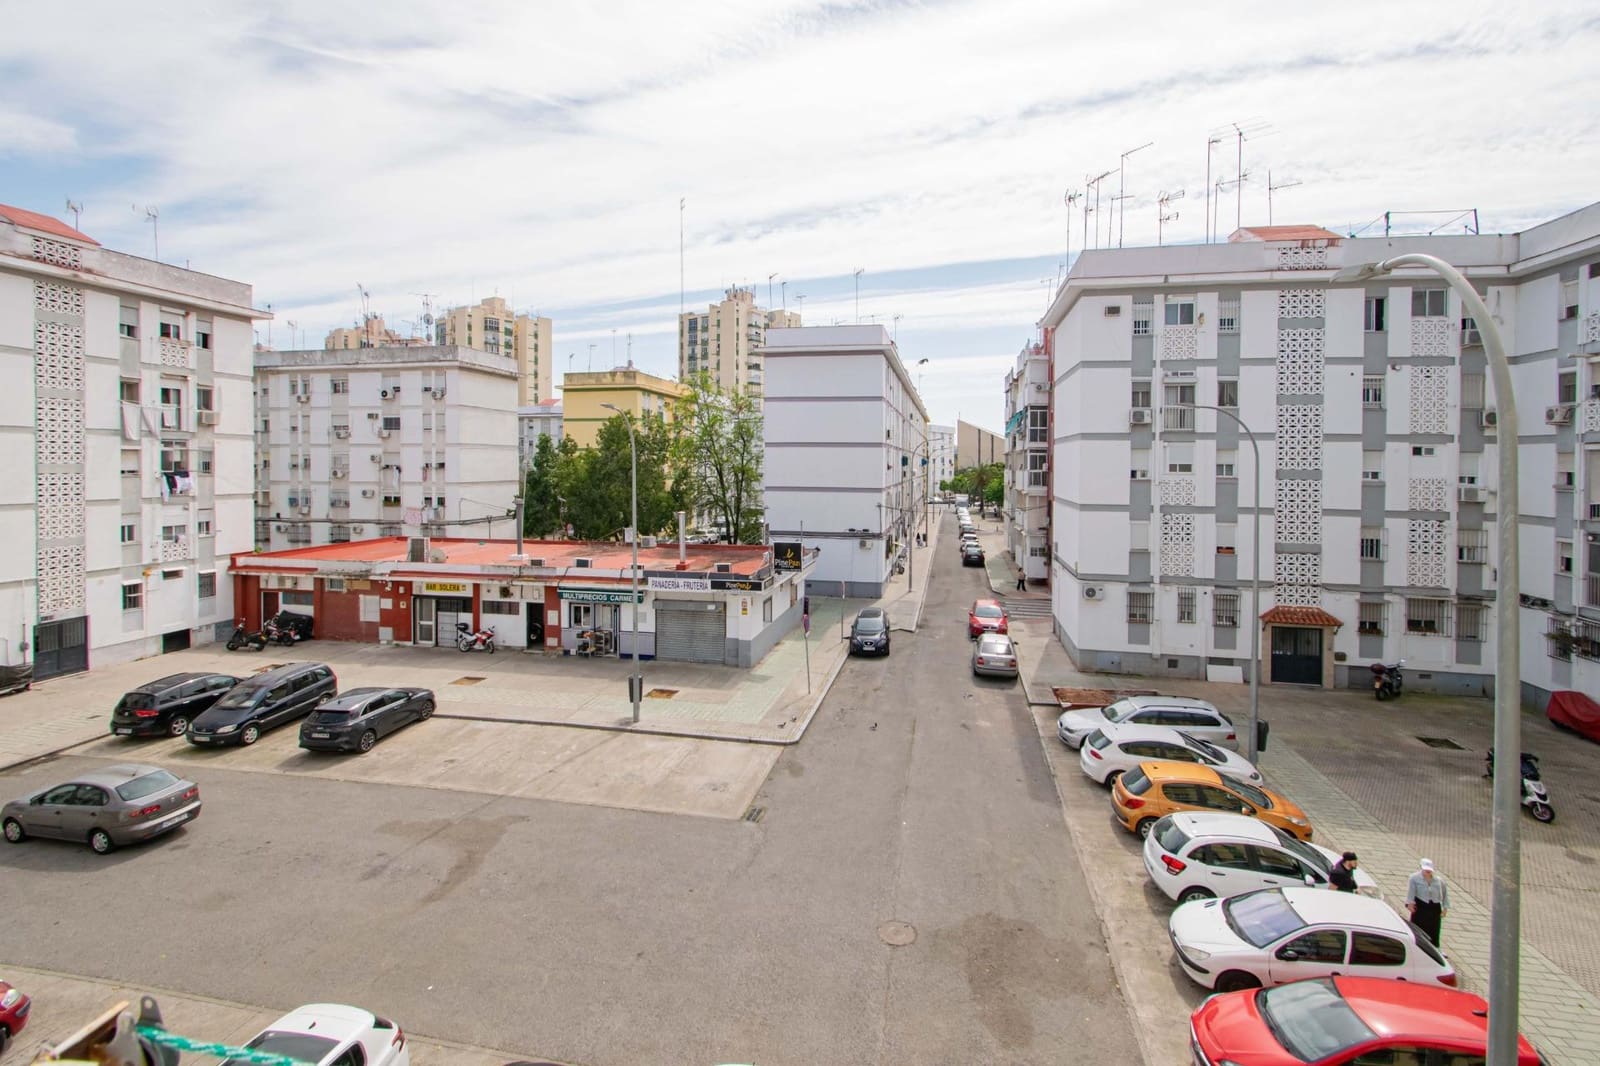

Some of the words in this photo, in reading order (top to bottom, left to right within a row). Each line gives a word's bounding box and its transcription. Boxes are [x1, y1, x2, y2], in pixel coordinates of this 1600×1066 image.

[426, 583, 437, 591] BAR
[562, 592, 607, 600] MULTIPRECIOS
[610, 594, 636, 602] CARME
